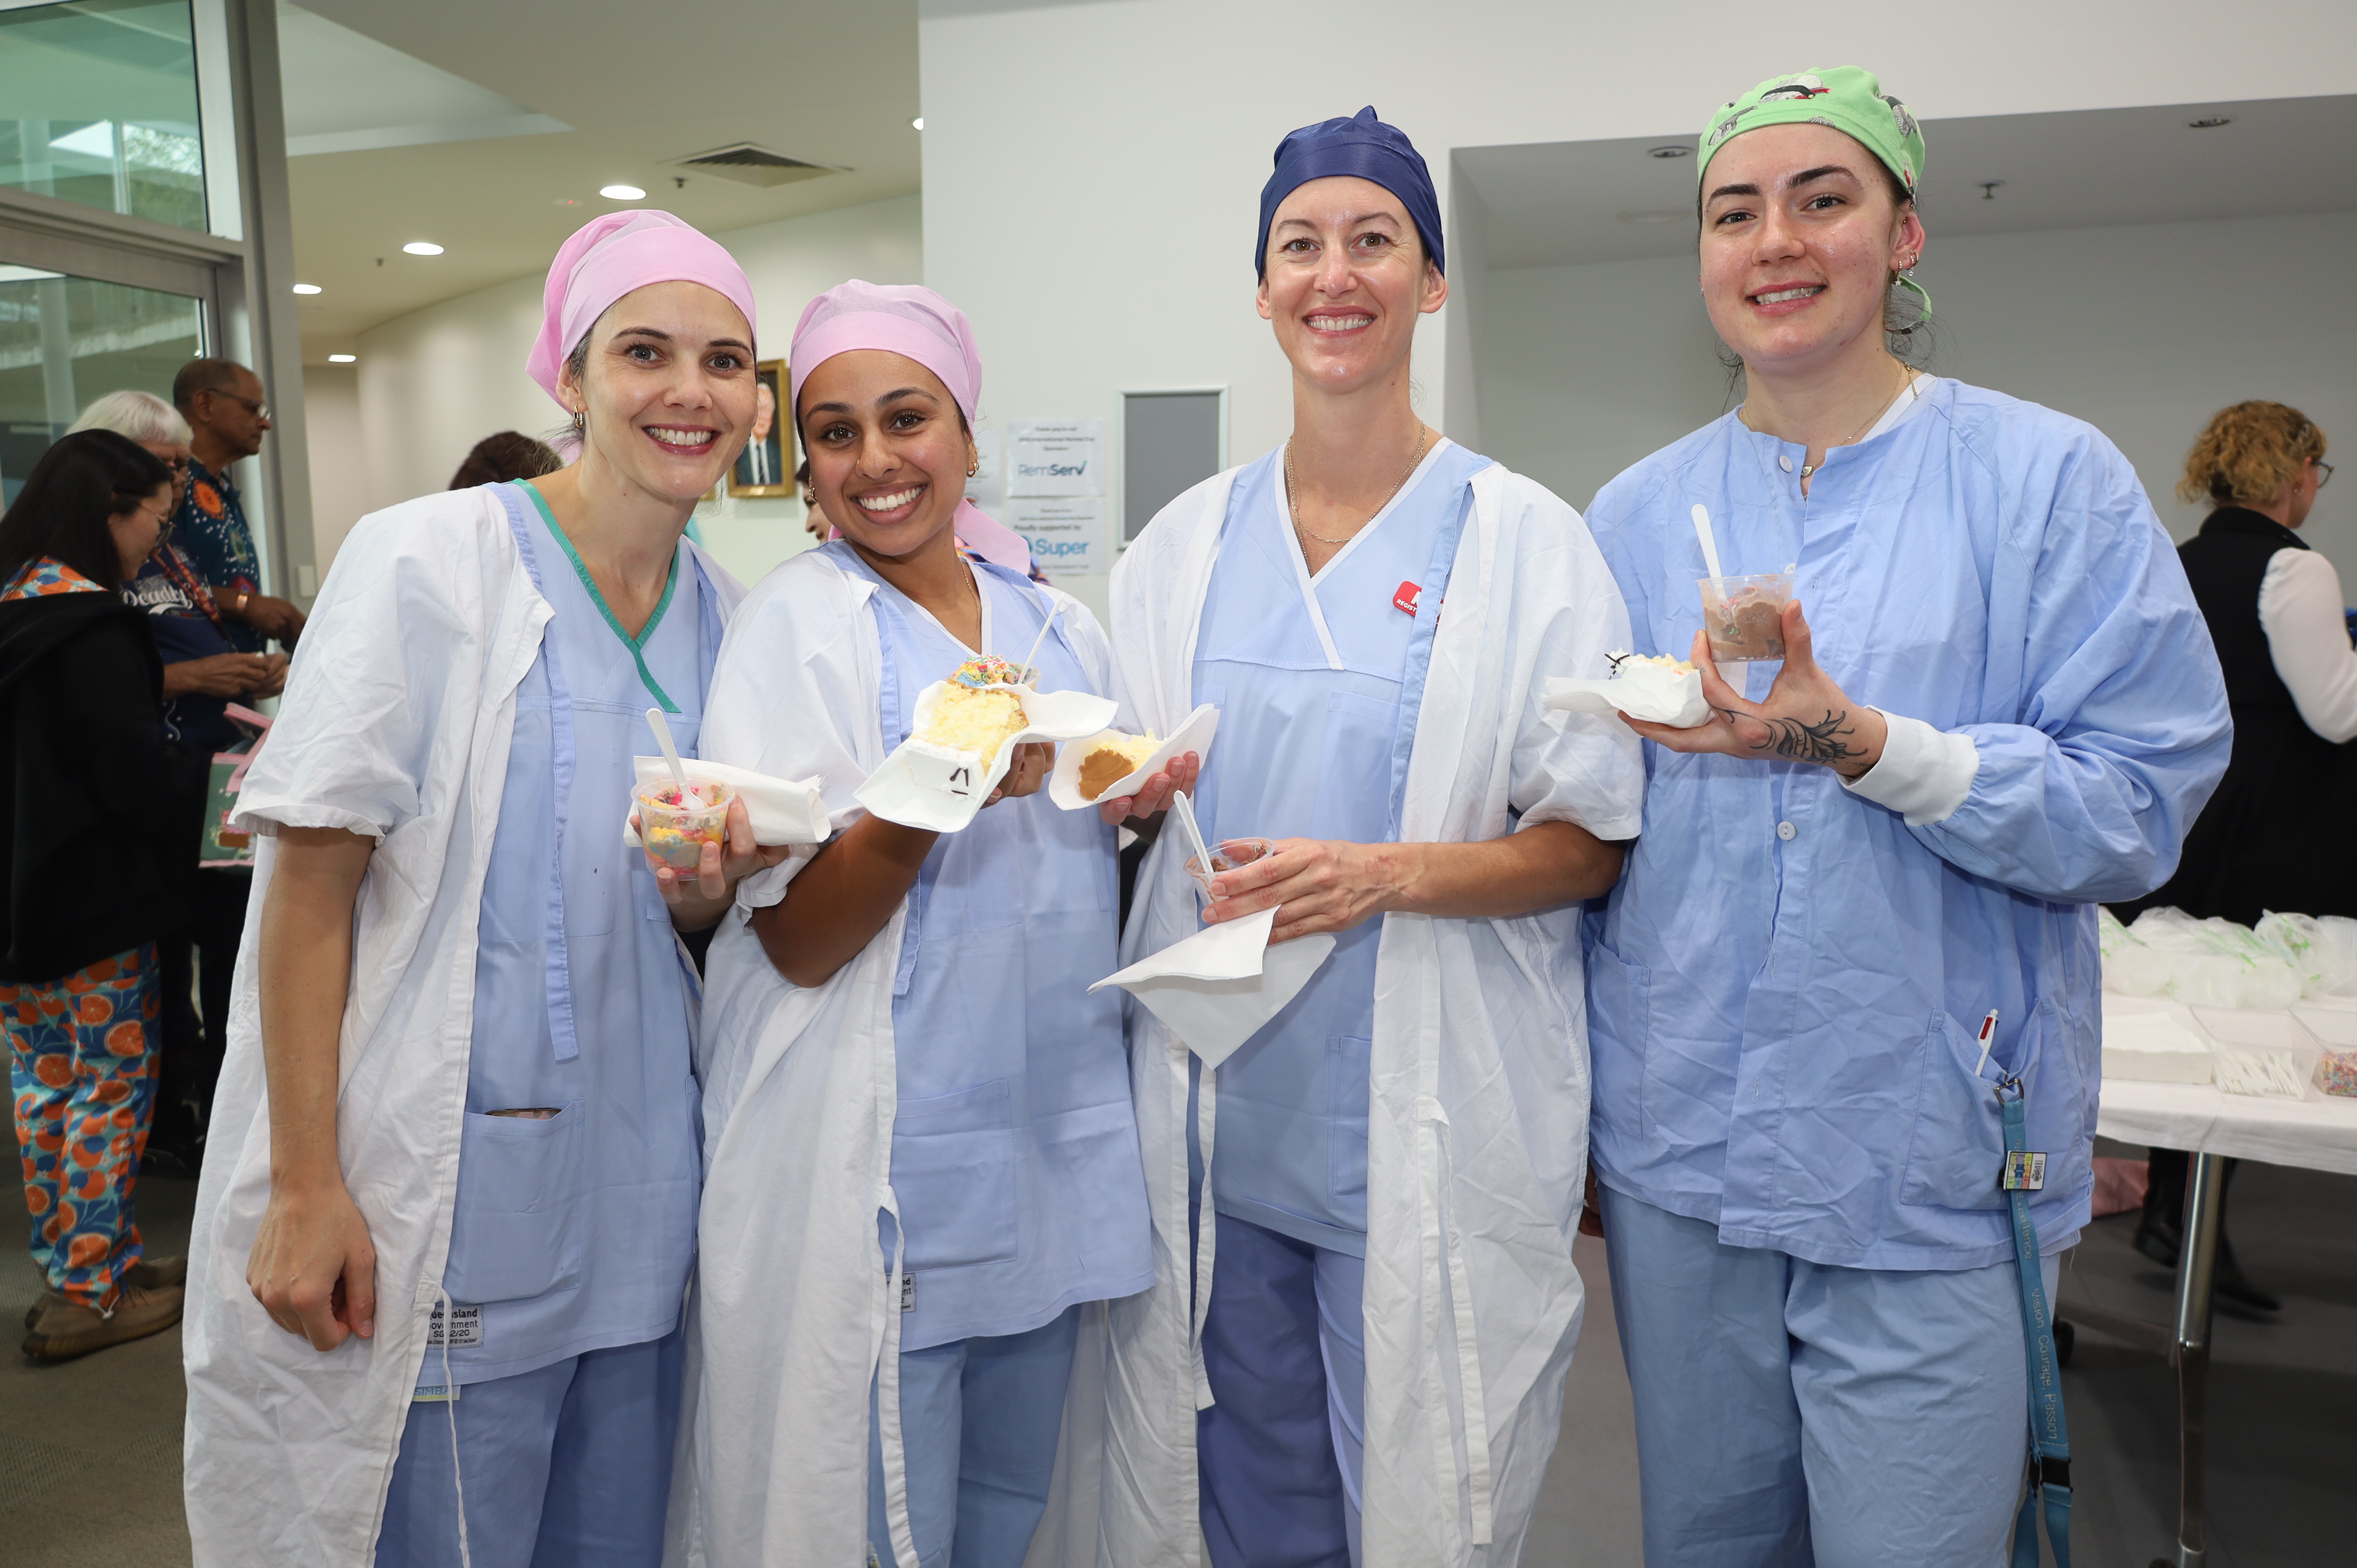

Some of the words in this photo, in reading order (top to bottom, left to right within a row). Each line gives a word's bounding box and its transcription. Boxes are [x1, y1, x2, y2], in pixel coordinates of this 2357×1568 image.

[1018, 460, 1088, 476] RemServ
[119, 585, 194, 610] Deadly
[1396, 598, 1417, 612] REGIST
[2016, 1191, 2033, 1259] Excellence
[2044, 1393, 2058, 1439] Passion
